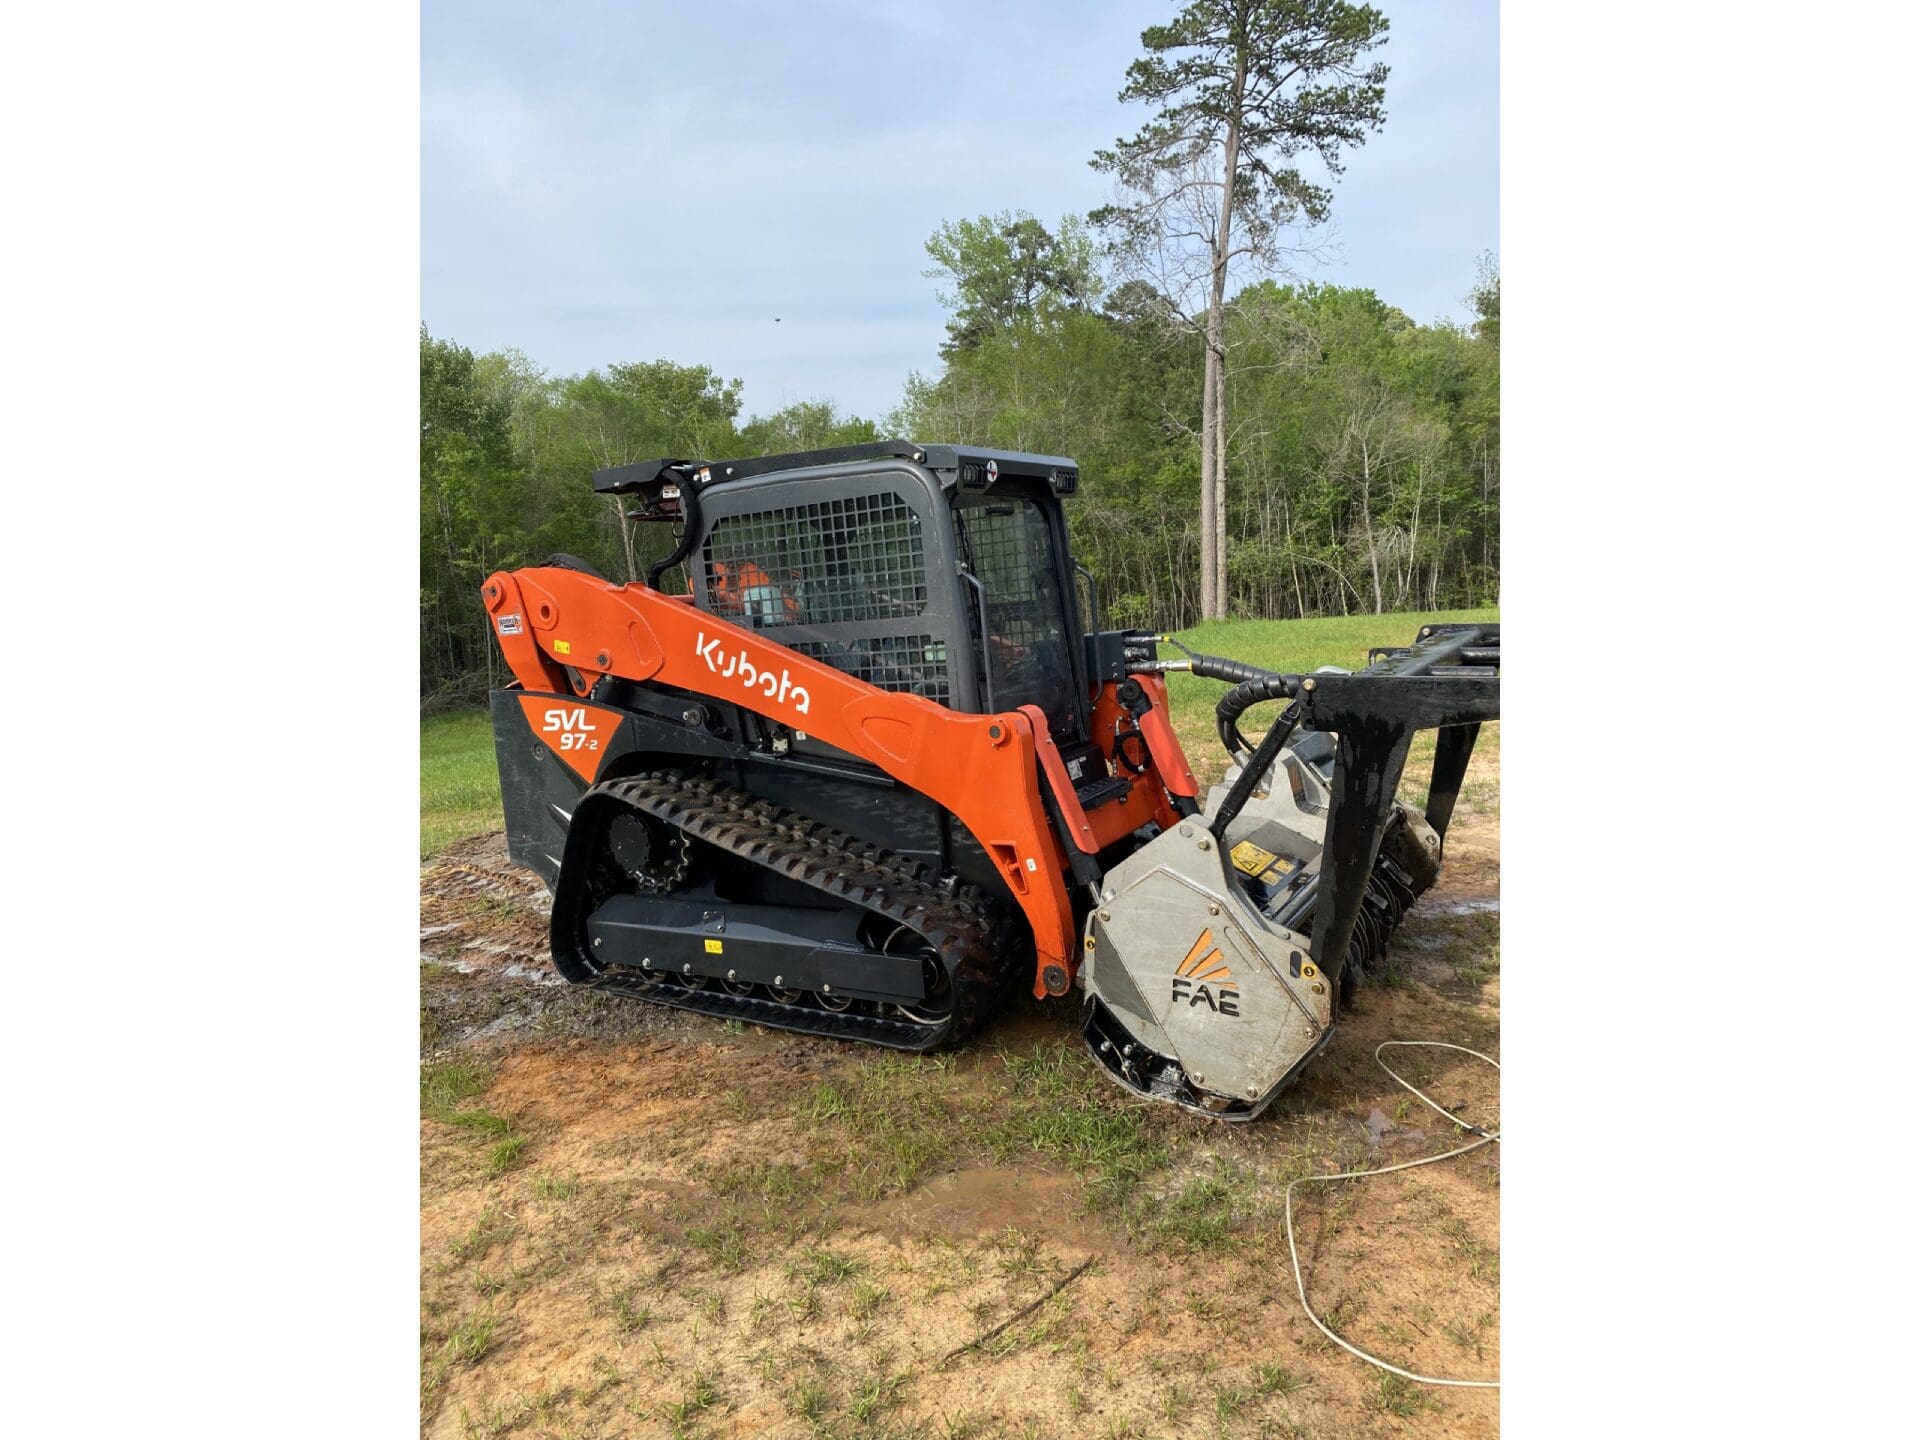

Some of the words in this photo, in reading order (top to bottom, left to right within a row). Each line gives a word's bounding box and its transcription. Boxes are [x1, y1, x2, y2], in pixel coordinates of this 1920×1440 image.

[695, 631, 810, 715] Kubota
[542, 708, 597, 731] SVL
[560, 732, 598, 750] 97-2
[1172, 978, 1240, 1017] FAE
